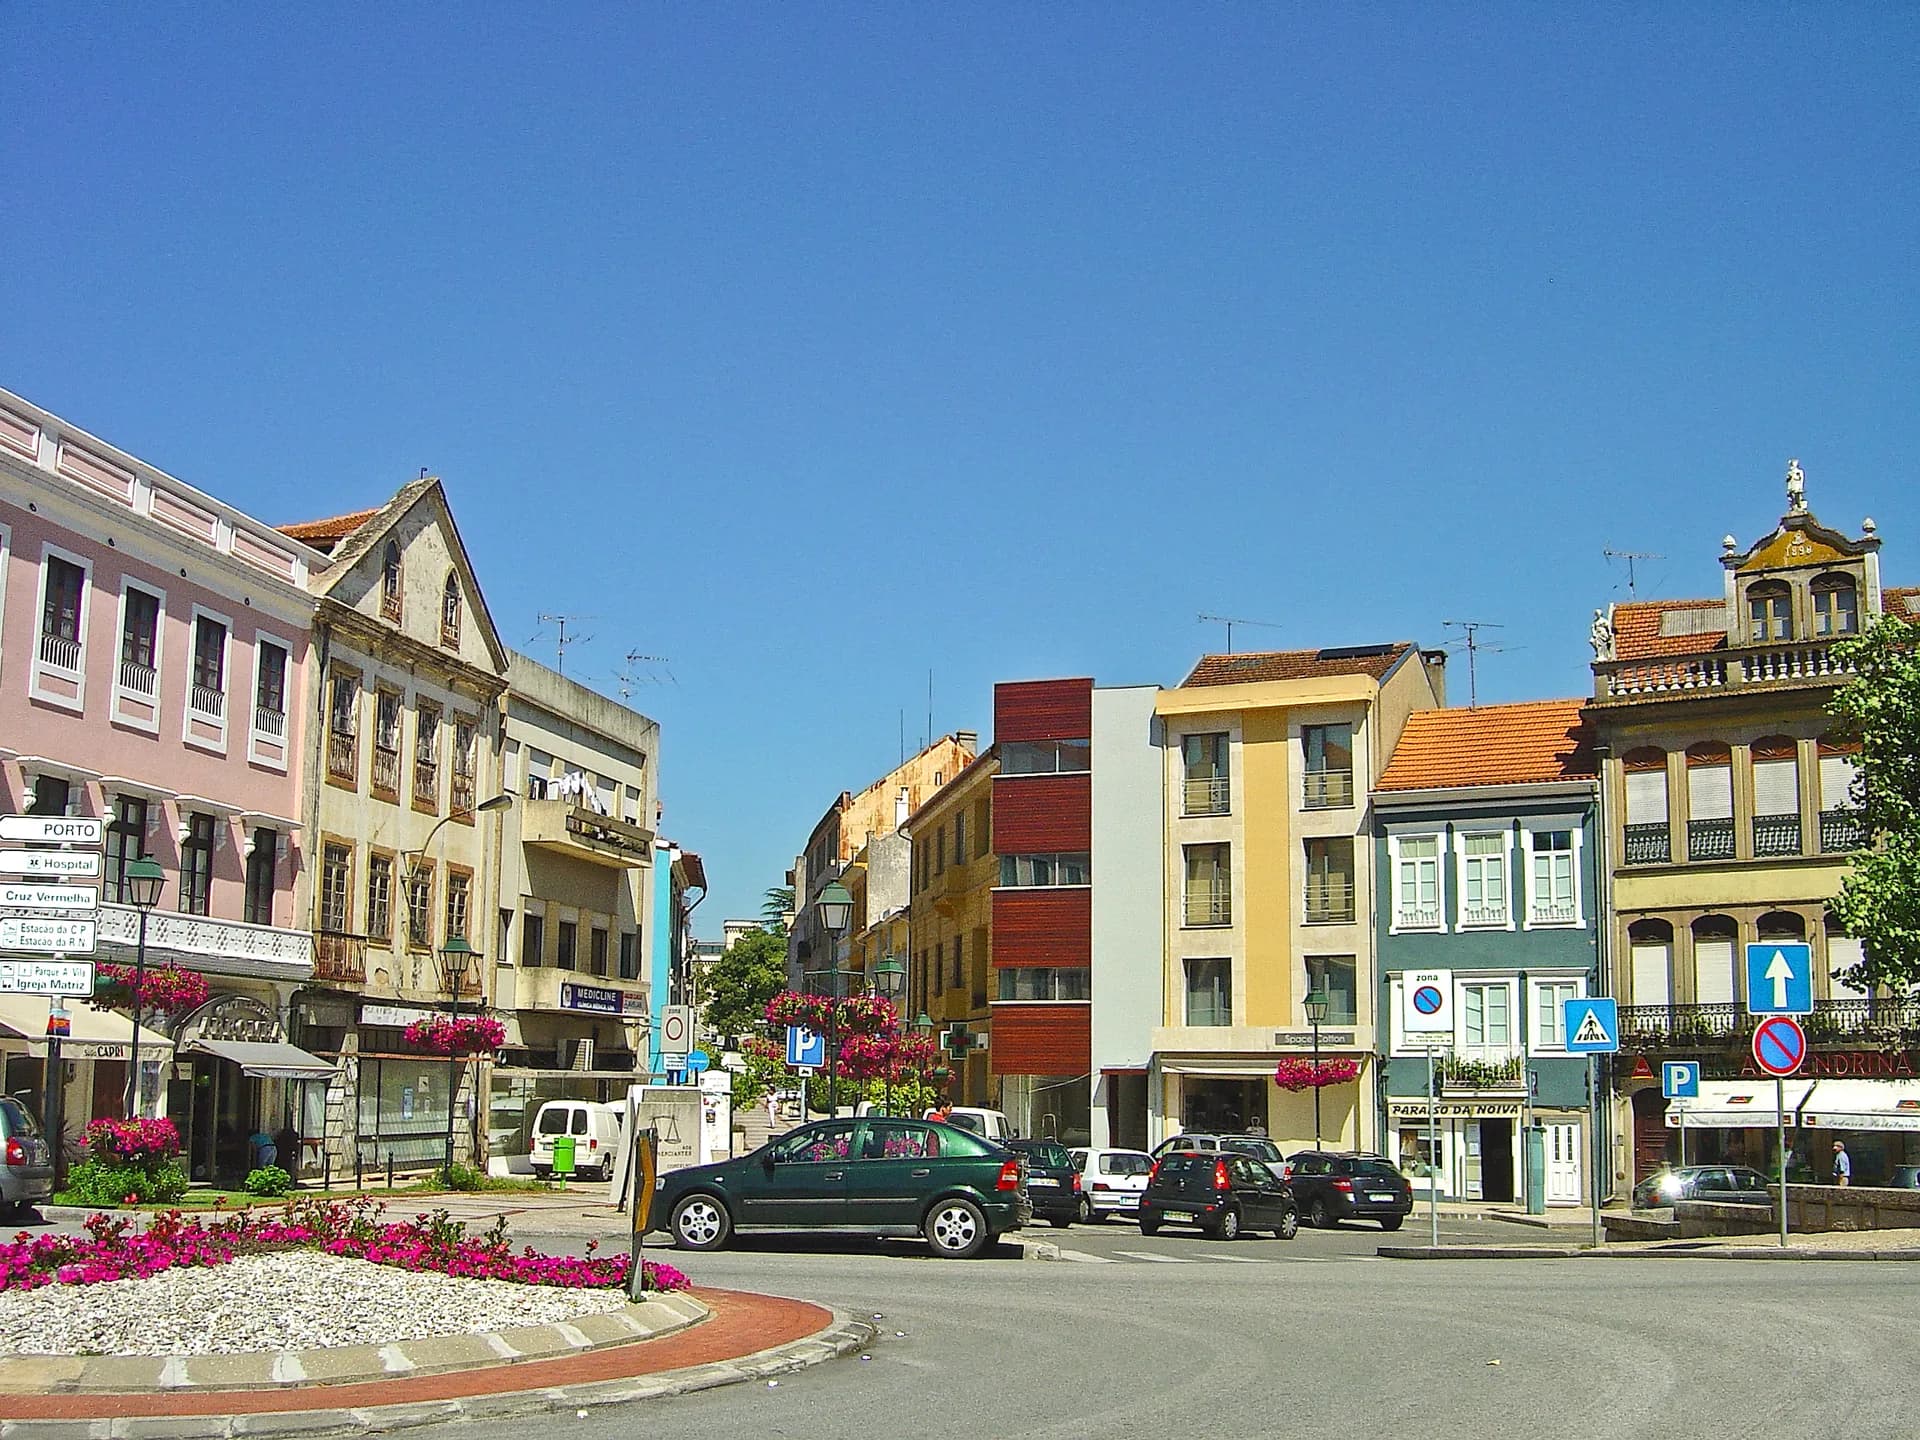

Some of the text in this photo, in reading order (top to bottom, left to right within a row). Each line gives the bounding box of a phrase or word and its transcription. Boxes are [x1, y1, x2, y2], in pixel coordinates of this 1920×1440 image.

[44, 823, 95, 837] PORTO
[44, 858, 93, 870] Hospital
[6, 890, 91, 903] Cruz Vermelha
[56, 924, 67, 934] da
[55, 938, 66, 946] da
[17, 978, 85, 990] Igreja Matriz
[1416, 974, 1439, 982] zona
[577, 987, 617, 1002] MEDICLINE
[97, 1045, 124, 1057] CAPRI
[1670, 1065, 1691, 1095] P
[1453, 1105, 1470, 1115] DA
[1476, 1105, 1518, 1114] NOIVA
